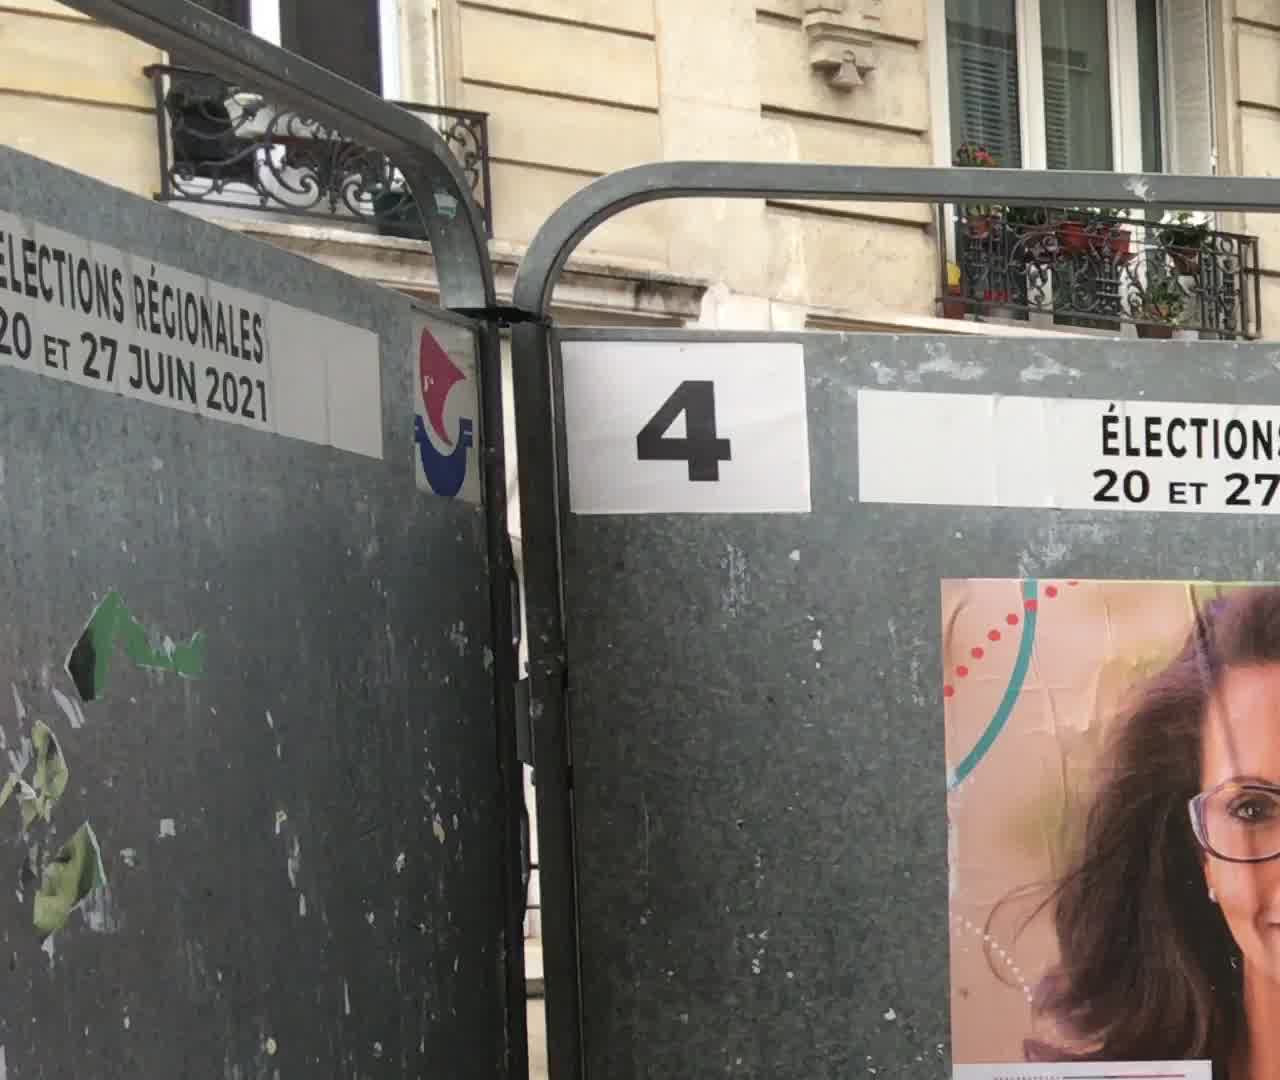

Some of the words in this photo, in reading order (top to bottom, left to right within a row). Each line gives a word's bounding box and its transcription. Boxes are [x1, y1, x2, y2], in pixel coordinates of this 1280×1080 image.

[0, 305, 32, 360] 20
[44, 335, 70, 370] ET
[80, 332, 117, 382] 27
[129, 344, 197, 403] JUIN
[205, 367, 267, 422] 2021
[133, 264, 263, 364] RÉGIONALES
[636, 380, 731, 482] 4
[1093, 470, 1150, 503] 20
[1169, 482, 1207, 505] ET
